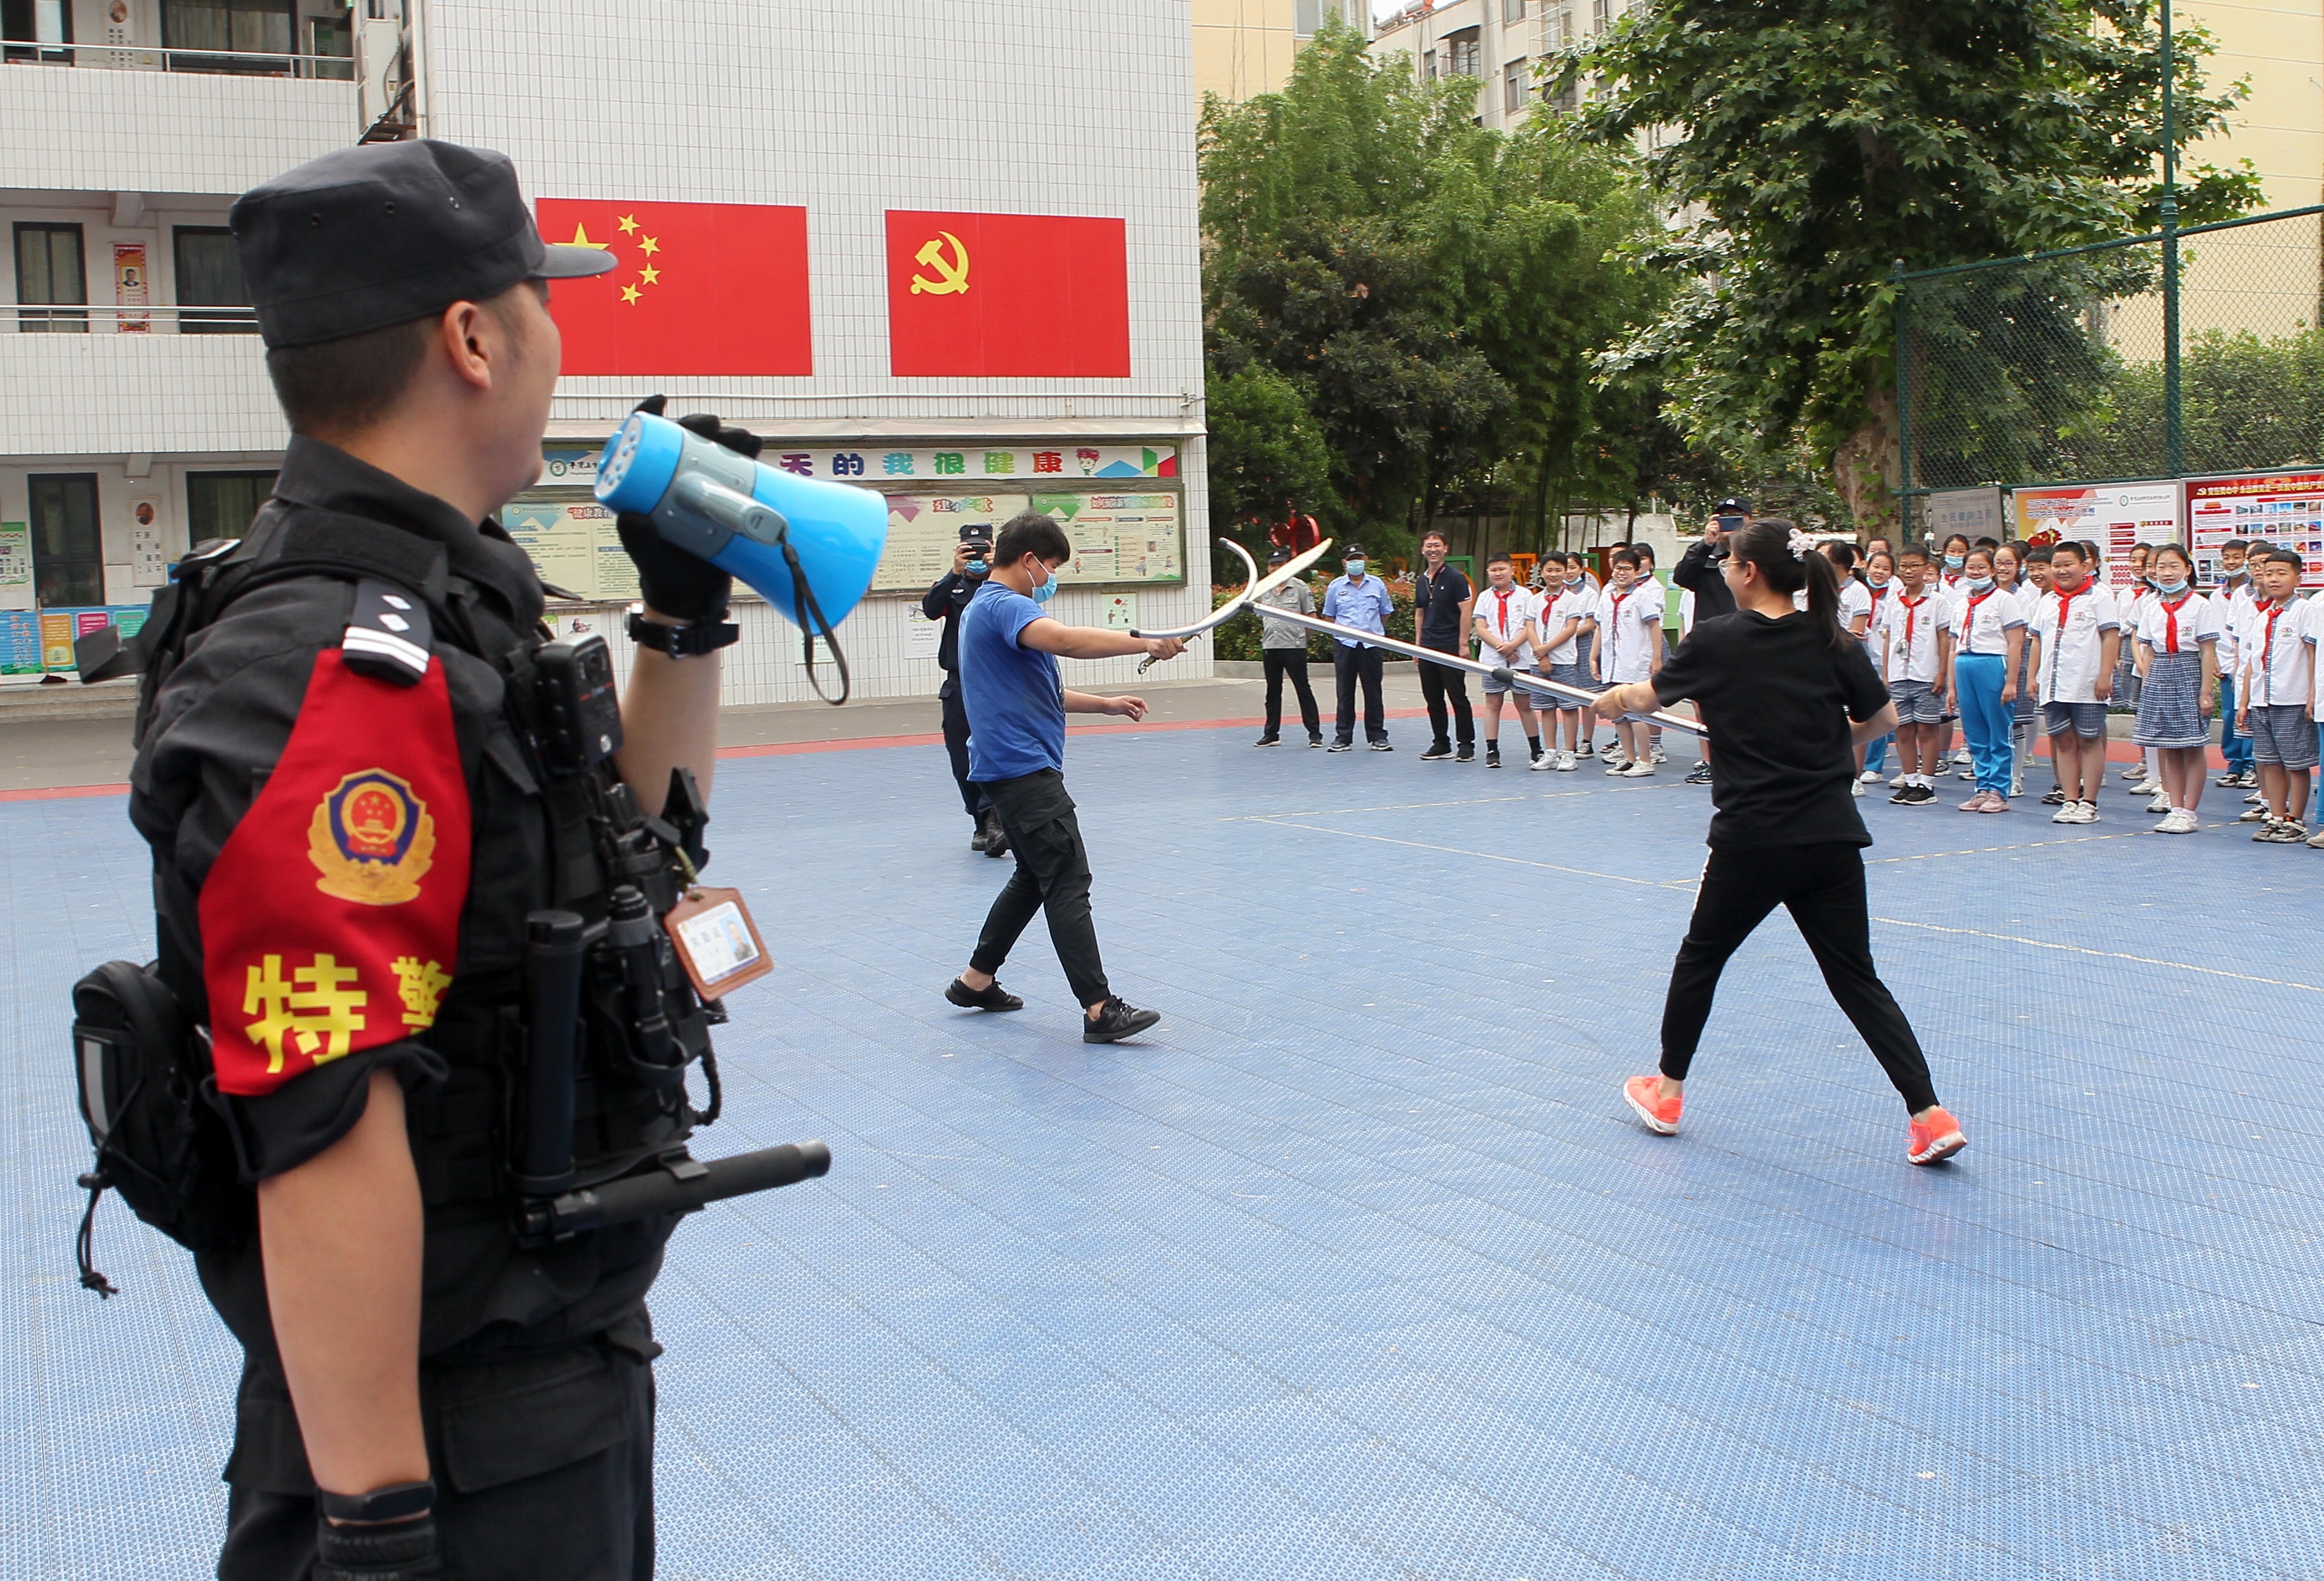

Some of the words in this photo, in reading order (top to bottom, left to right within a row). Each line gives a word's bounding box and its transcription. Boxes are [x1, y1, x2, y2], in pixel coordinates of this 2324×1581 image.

[780, 451, 1061, 476] 天的我很健康
[243, 953, 453, 1073] 特警
